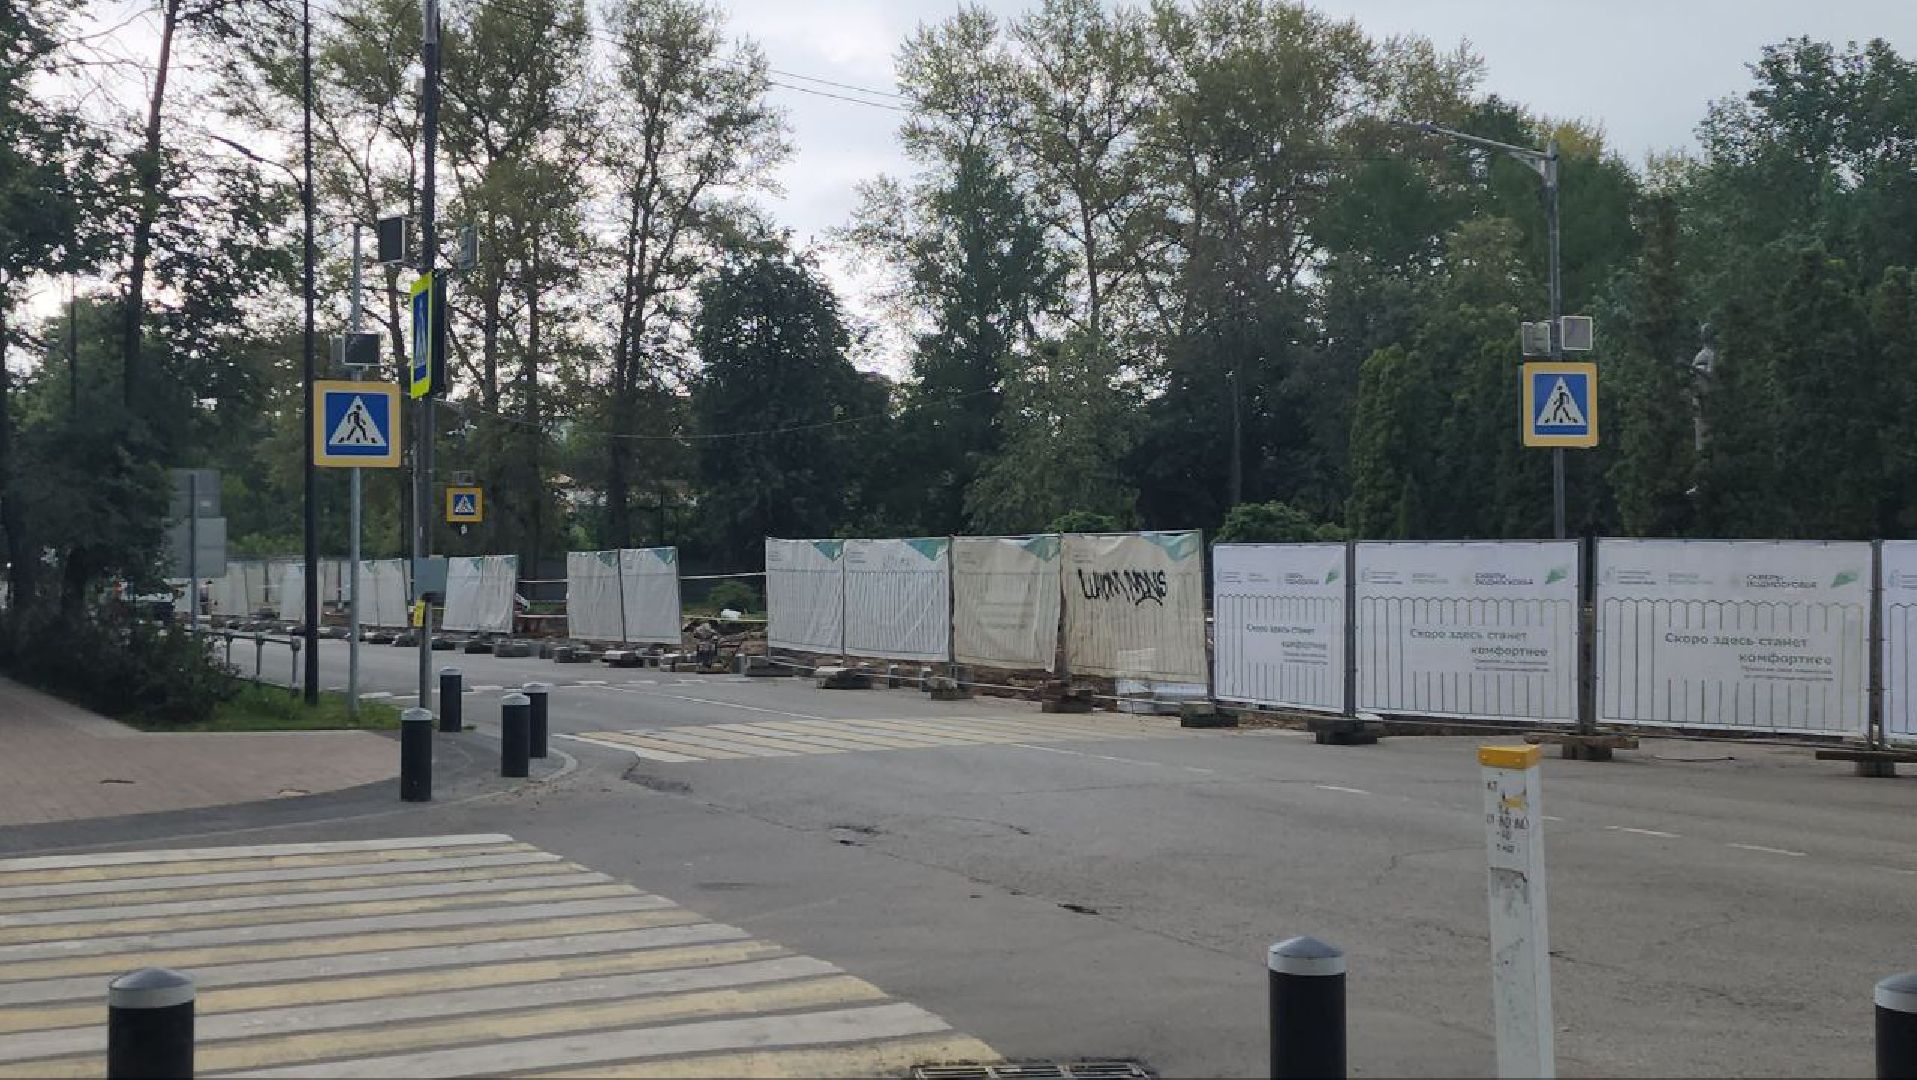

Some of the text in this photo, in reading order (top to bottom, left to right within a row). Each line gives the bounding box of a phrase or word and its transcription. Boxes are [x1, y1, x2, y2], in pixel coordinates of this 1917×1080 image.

[1410, 628, 1528, 641] Скоро здесь станет
[1664, 632, 1807, 648] Скоро здесь станет
[1471, 646, 1548, 657] комфортнее
[1739, 653, 1832, 666] комфортнее
